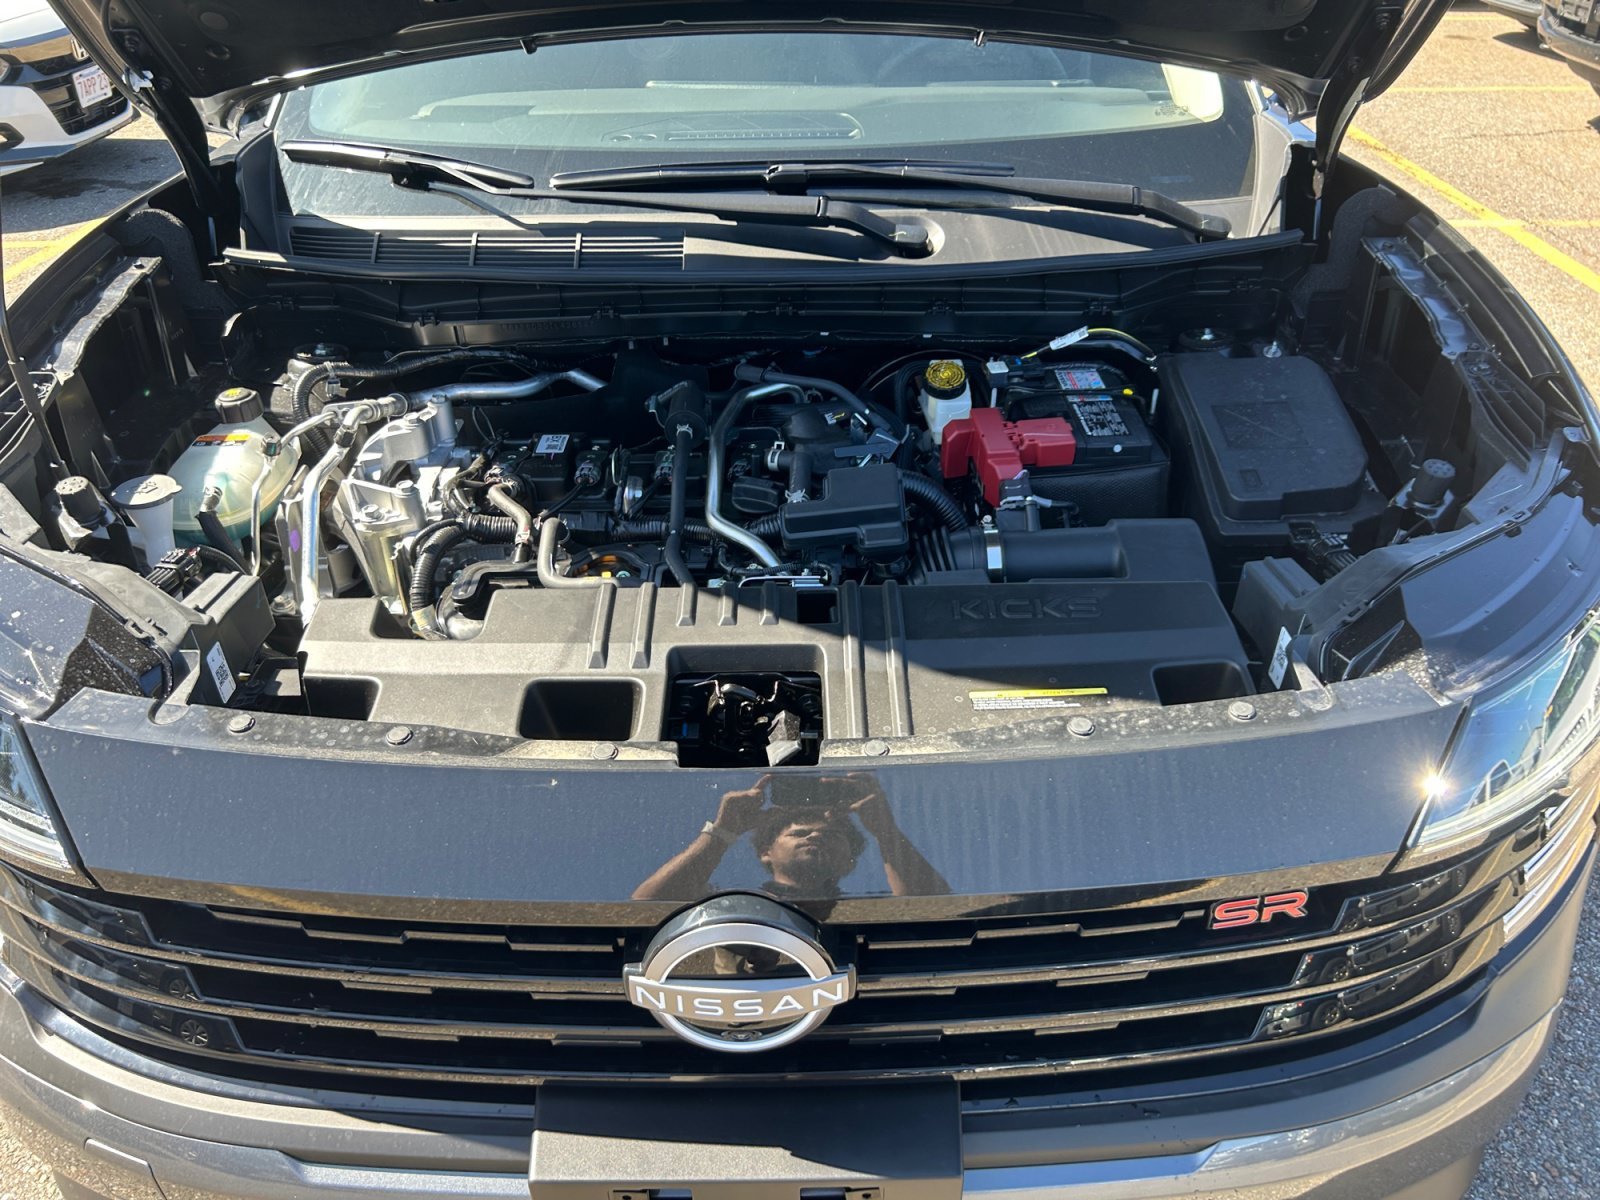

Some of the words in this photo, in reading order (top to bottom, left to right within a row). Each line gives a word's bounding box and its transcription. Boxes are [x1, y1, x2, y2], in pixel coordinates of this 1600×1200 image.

[952, 598, 1102, 619] KICKS
[1211, 890, 1308, 930] SR
[635, 982, 843, 1017] NISSAN
